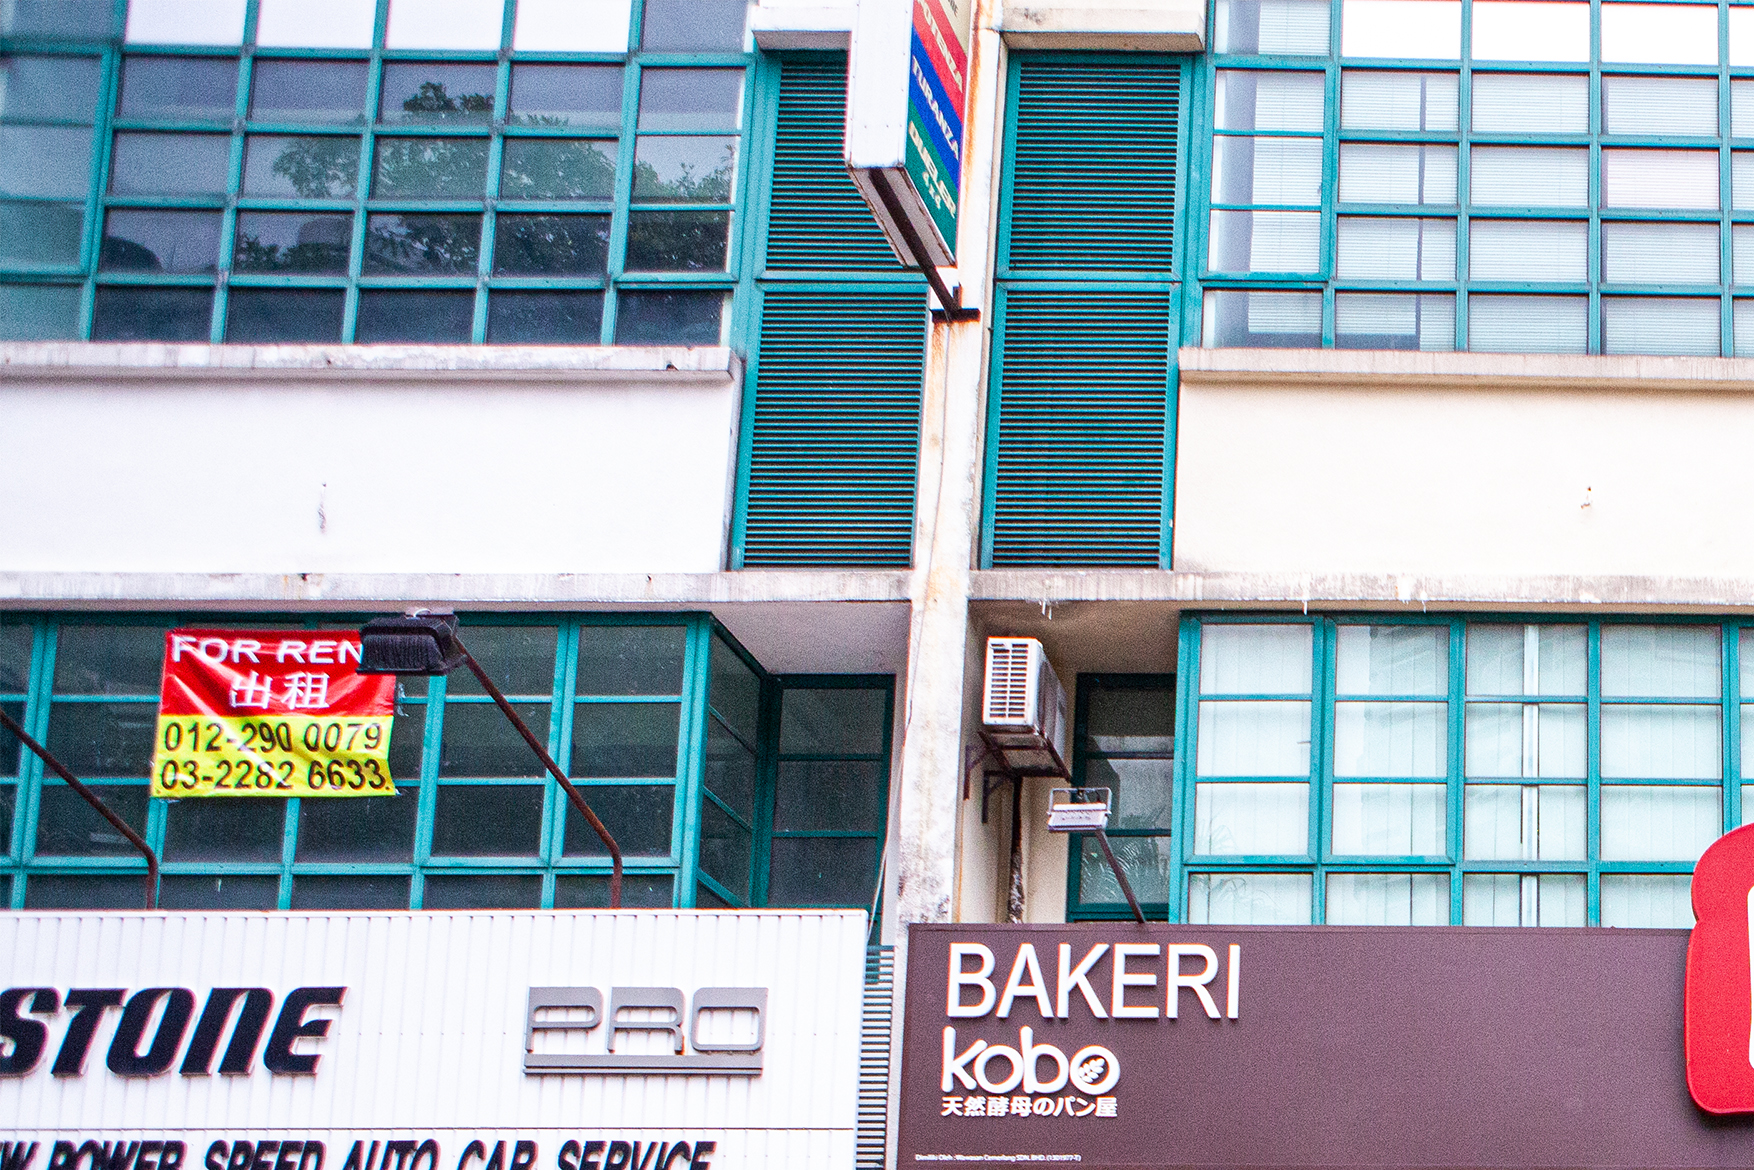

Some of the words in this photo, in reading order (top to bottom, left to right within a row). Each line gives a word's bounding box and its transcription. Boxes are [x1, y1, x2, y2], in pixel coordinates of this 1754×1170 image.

[917, 0, 963, 93] OTENZA
[912, 54, 959, 161] TURANZA
[908, 120, 956, 219] DUELER
[171, 636, 261, 663] FOR
[276, 639, 363, 664] REN
[229, 670, 331, 710] 出租
[164, 722, 294, 753] 012-290
[303, 722, 383, 753] 0079
[161, 759, 296, 791] 03-2282
[946, 942, 1242, 1020] BAKERI
[525, 986, 769, 1053] PRO
[941, 1025, 1121, 1095] kobo
[941, 1096, 1119, 1118] 天然酵母のパン屋
